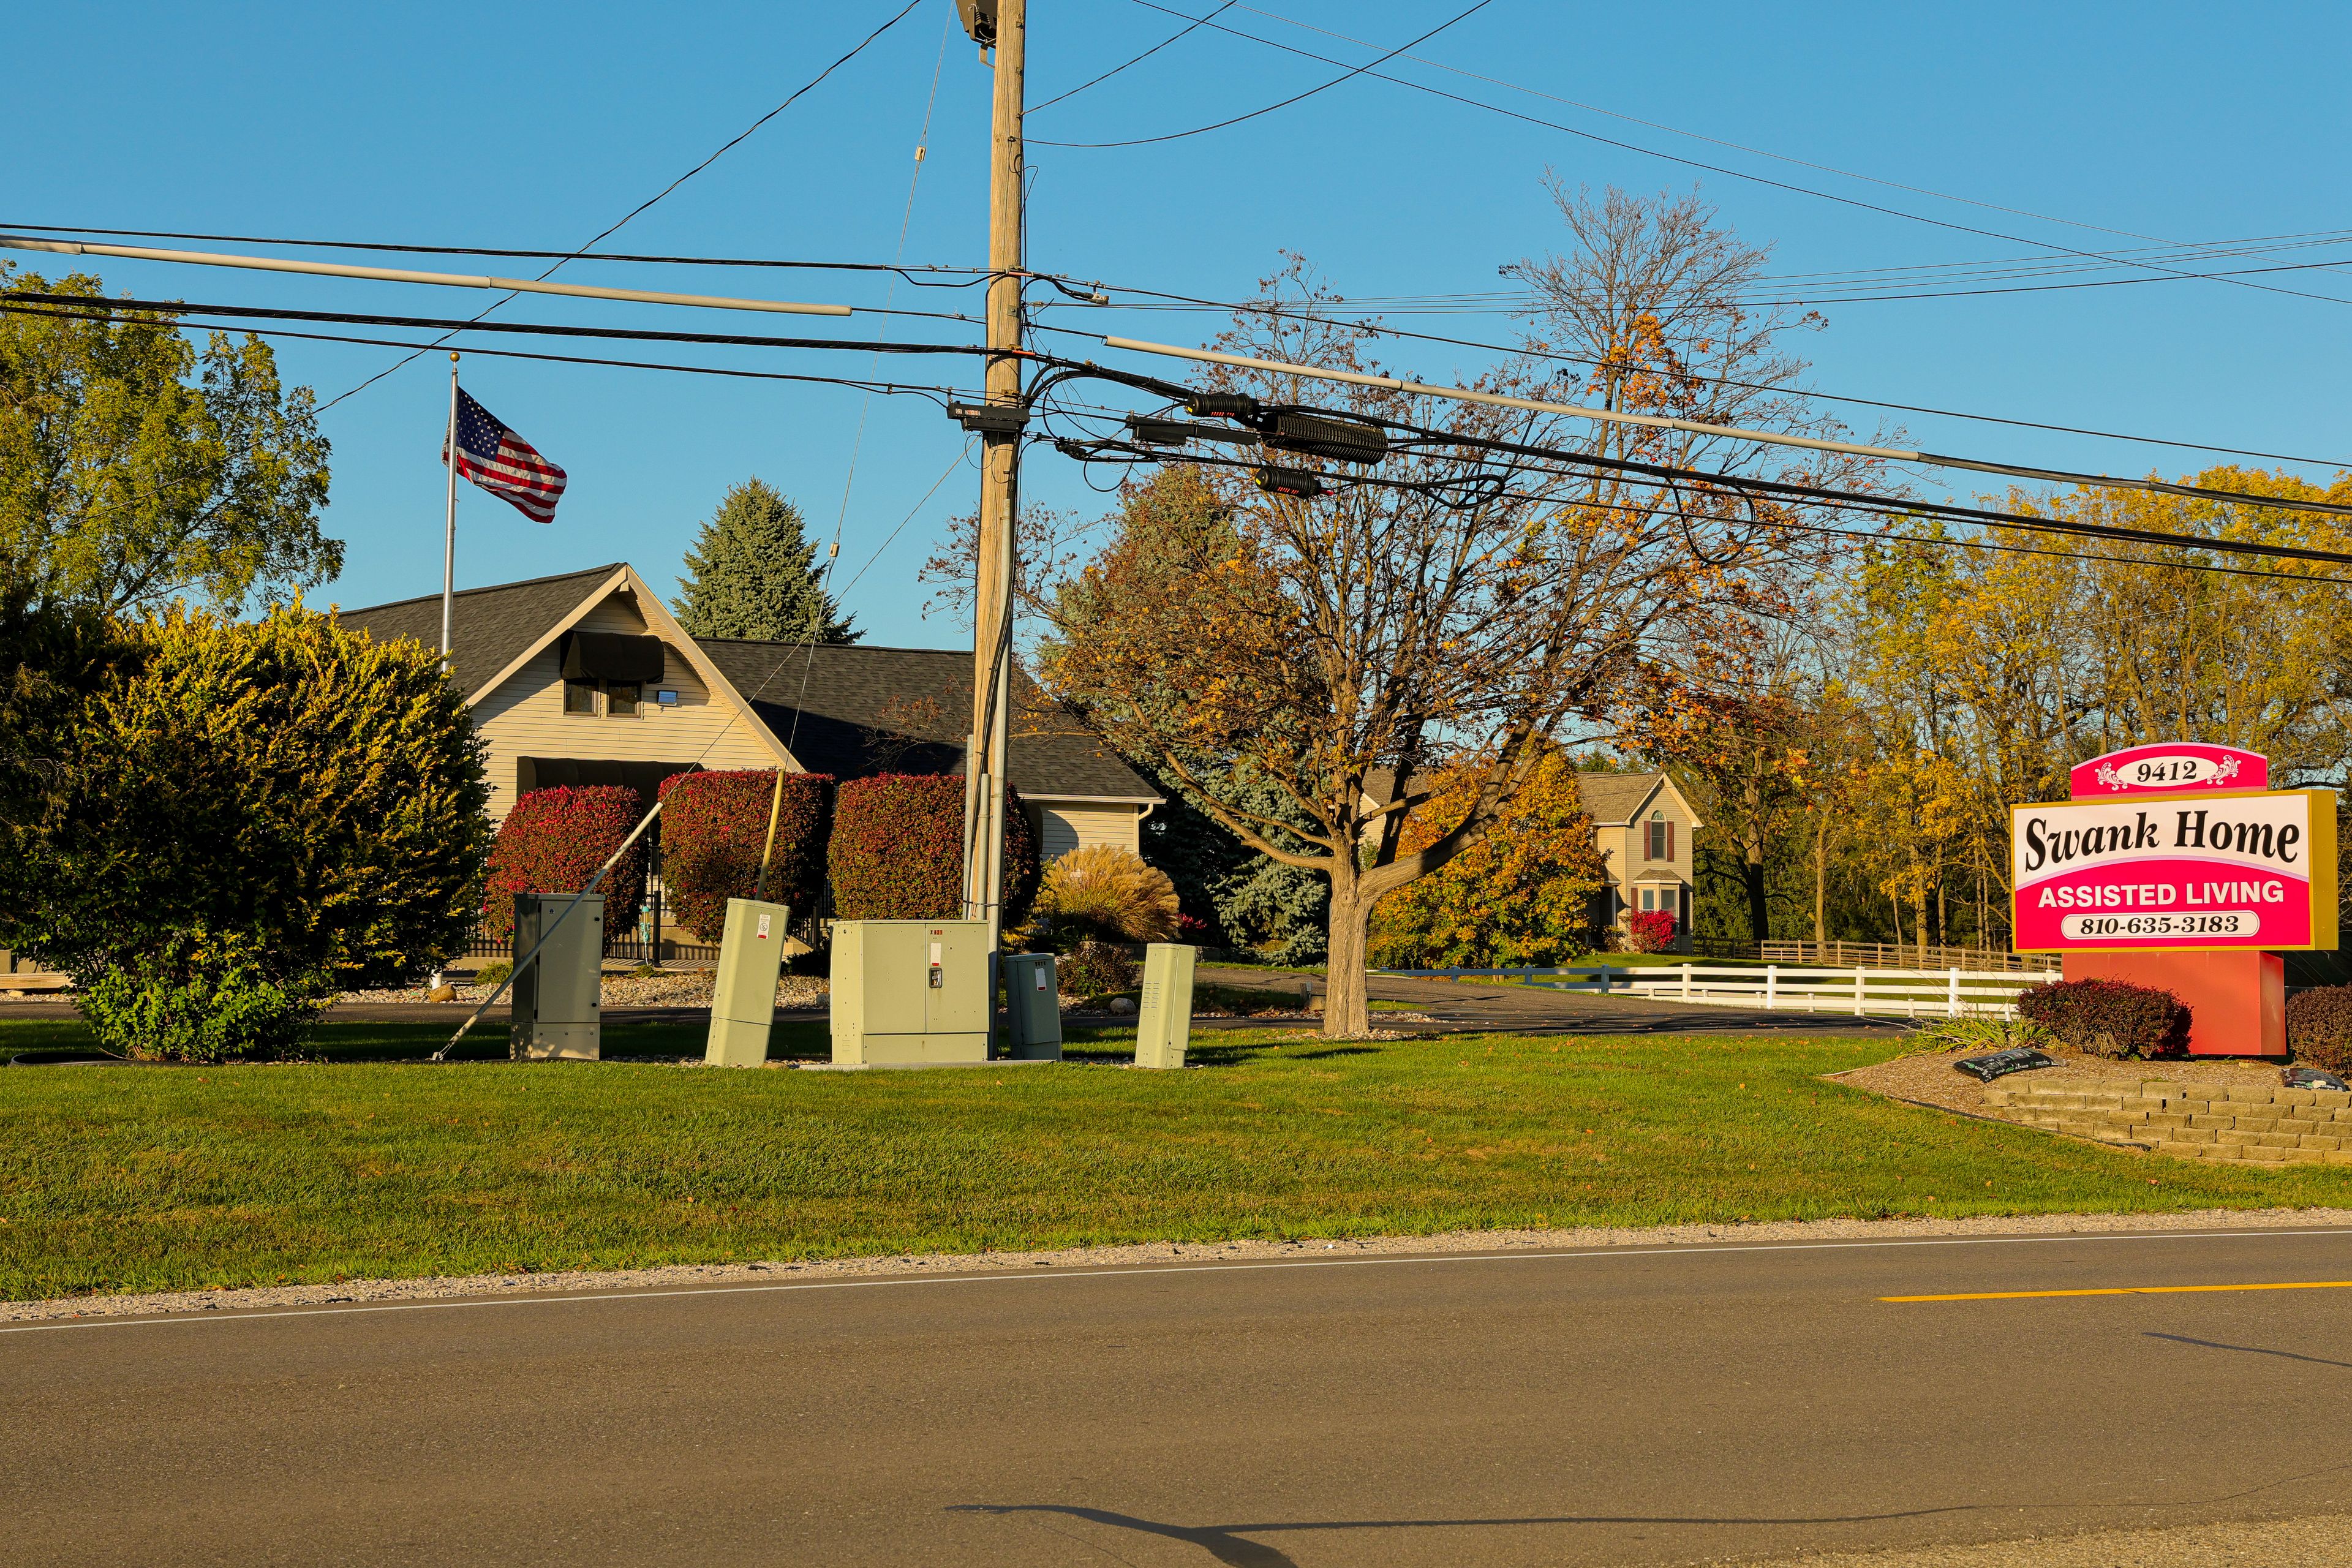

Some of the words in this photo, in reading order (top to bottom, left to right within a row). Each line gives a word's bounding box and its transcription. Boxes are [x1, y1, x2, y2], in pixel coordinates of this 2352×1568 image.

[2137, 761, 2196, 782] 9412
[2025, 812, 2160, 873] Swank
[2174, 810, 2299, 863] Home
[2038, 883, 2176, 908] ASSISTED
[2186, 880, 2283, 904] LIVING
[2080, 916, 2239, 935] 810-635-3183
